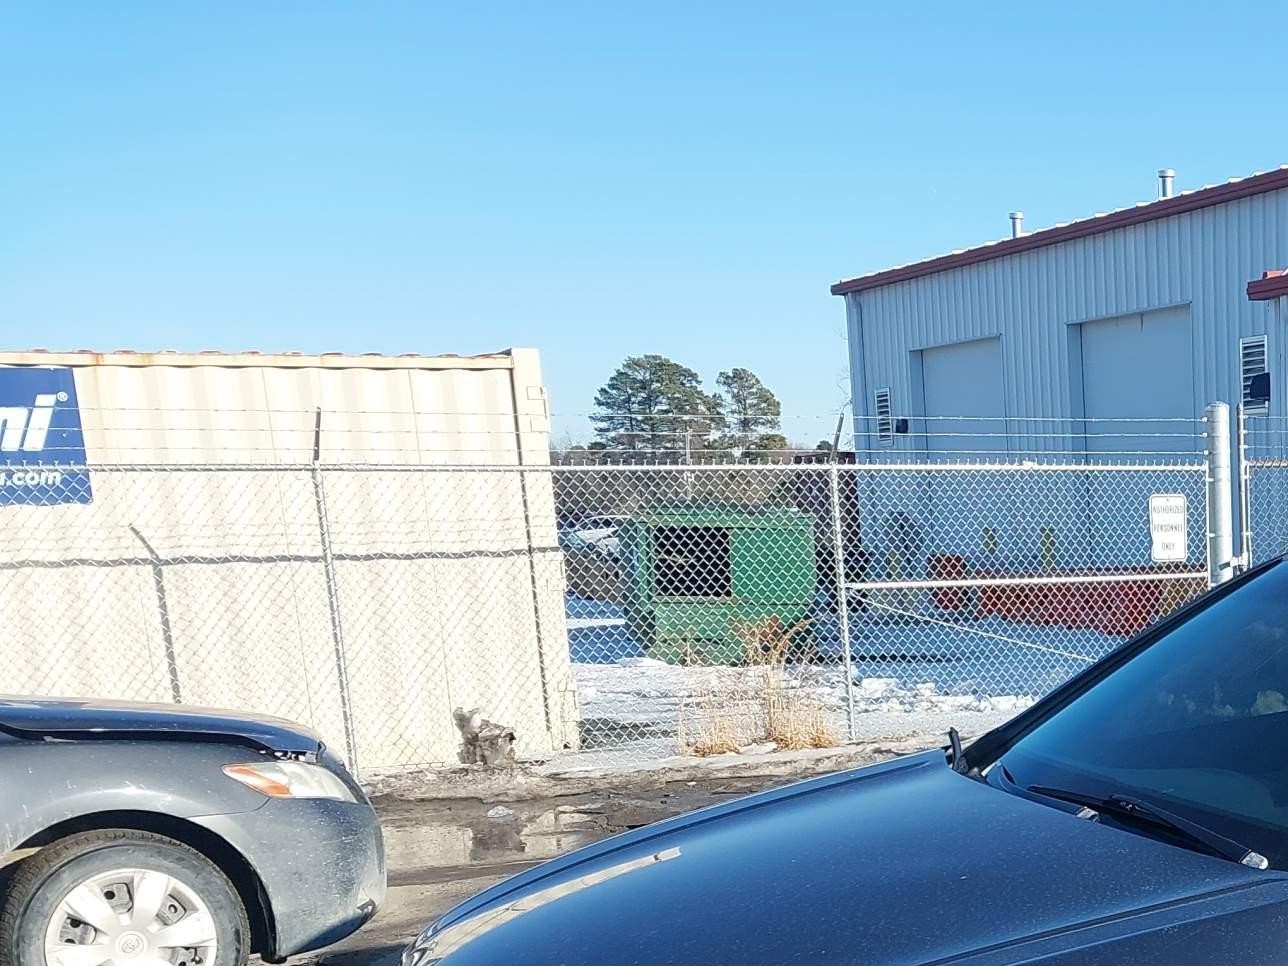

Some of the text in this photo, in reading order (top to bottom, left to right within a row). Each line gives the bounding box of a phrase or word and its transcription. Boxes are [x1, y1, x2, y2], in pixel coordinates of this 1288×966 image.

[1153, 505, 1184, 514] AUTHORIZED
[1153, 523, 1183, 533] PERSONNEL
[1161, 541, 1175, 550] ONLY
